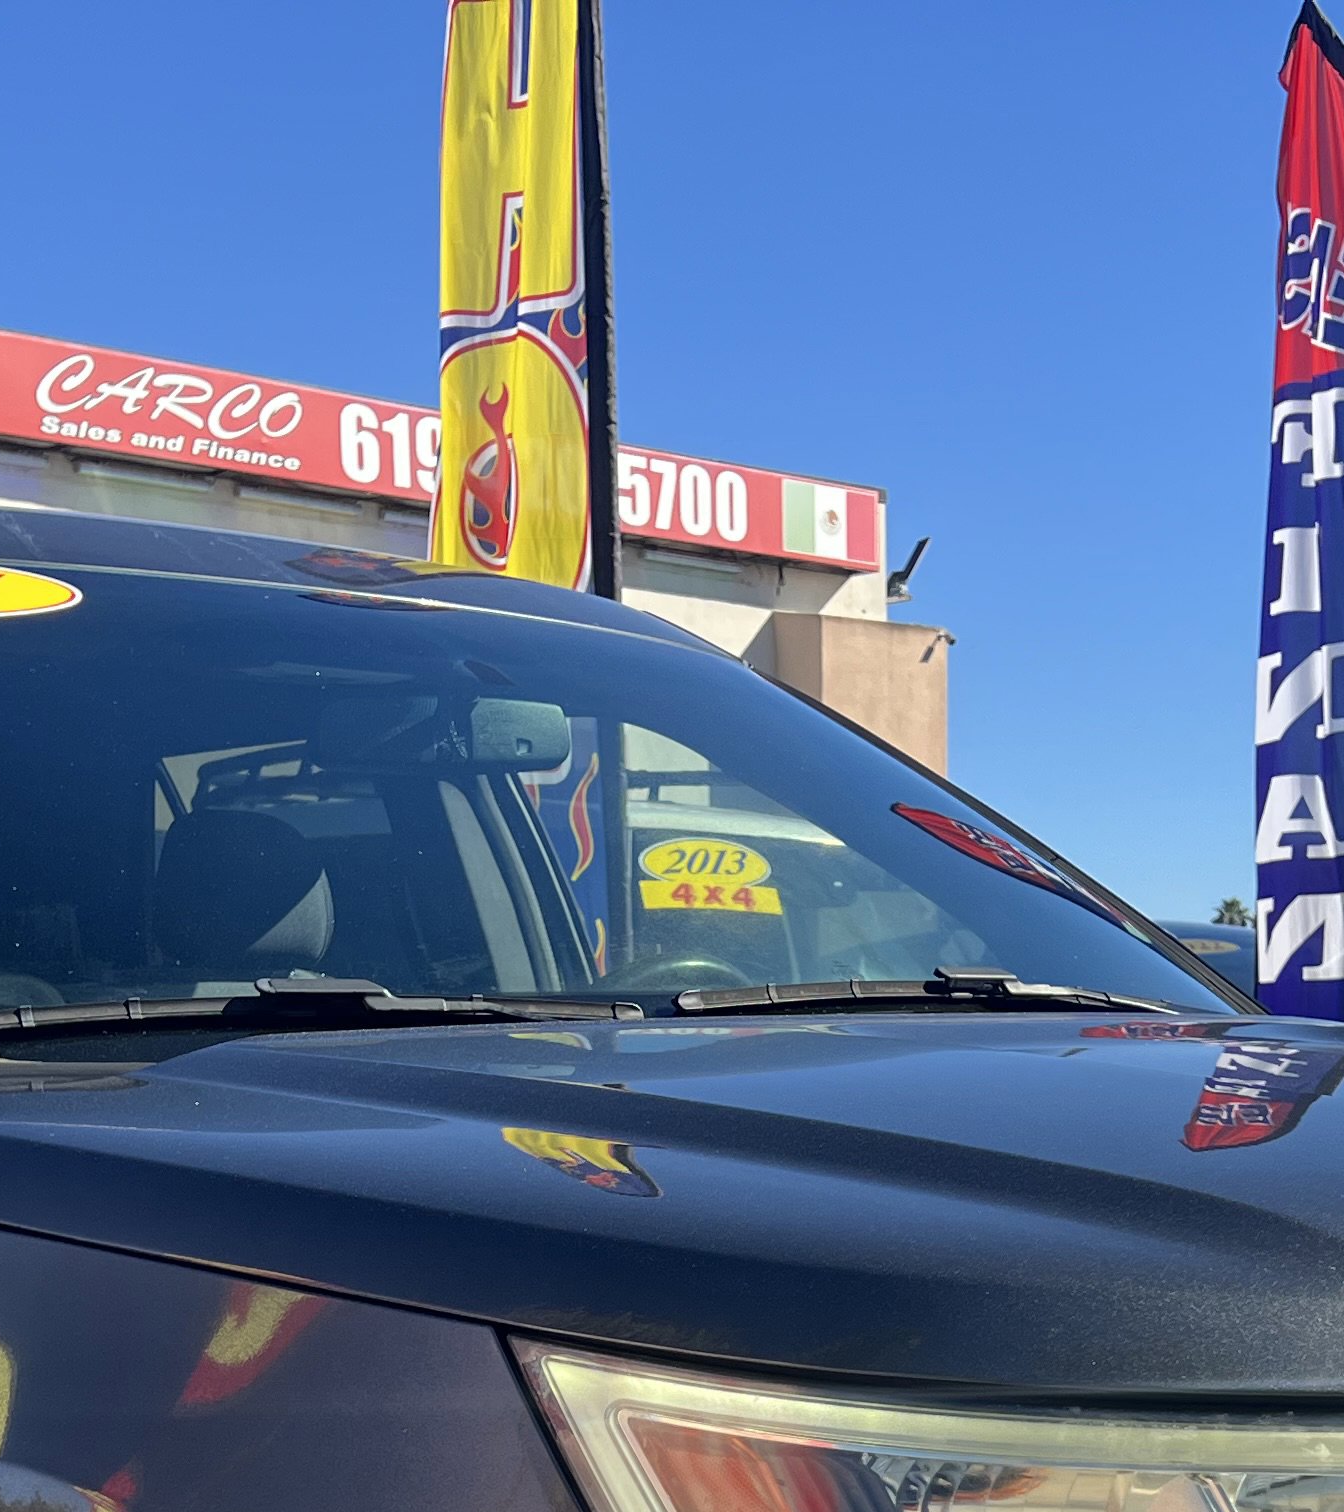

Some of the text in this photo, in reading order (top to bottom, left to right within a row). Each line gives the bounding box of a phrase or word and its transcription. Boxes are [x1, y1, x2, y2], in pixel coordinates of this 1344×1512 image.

[35, 354, 303, 440] CARCO
[40, 415, 302, 471] Sales and Finance
[618, 451, 749, 542] 5700
[661, 848, 748, 876] 2013
